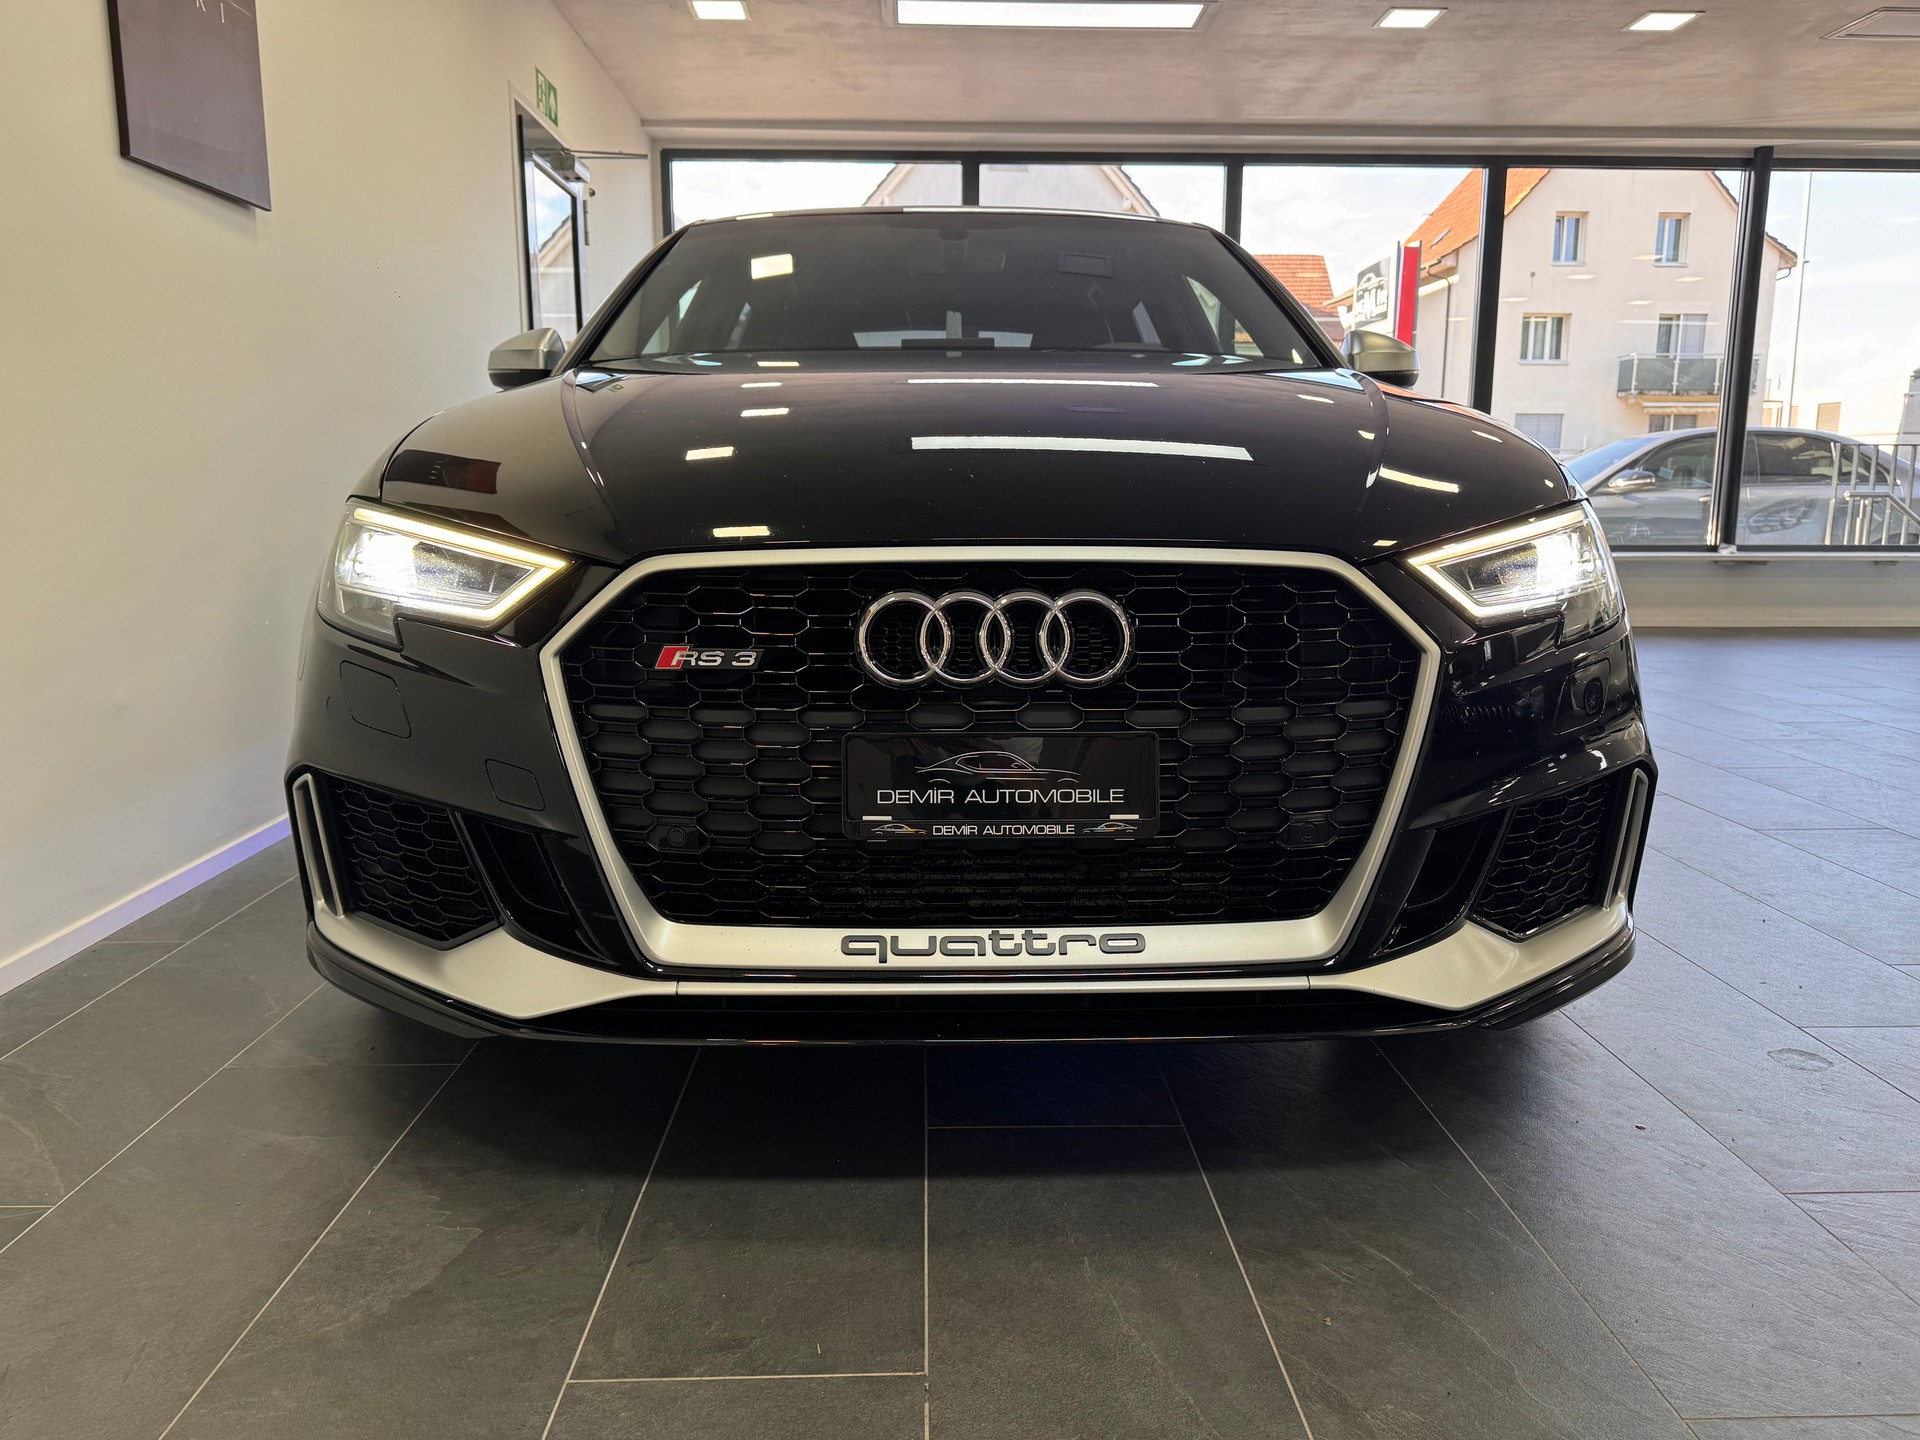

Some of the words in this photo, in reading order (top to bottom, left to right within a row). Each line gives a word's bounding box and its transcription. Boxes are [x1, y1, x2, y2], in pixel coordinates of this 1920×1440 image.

[671, 650, 724, 666] RS
[731, 651, 757, 667] 3
[964, 788, 1125, 804] AUTOMOBILE
[982, 824, 1075, 835] AUTOMOBILE
[840, 929, 1147, 964] quattro
